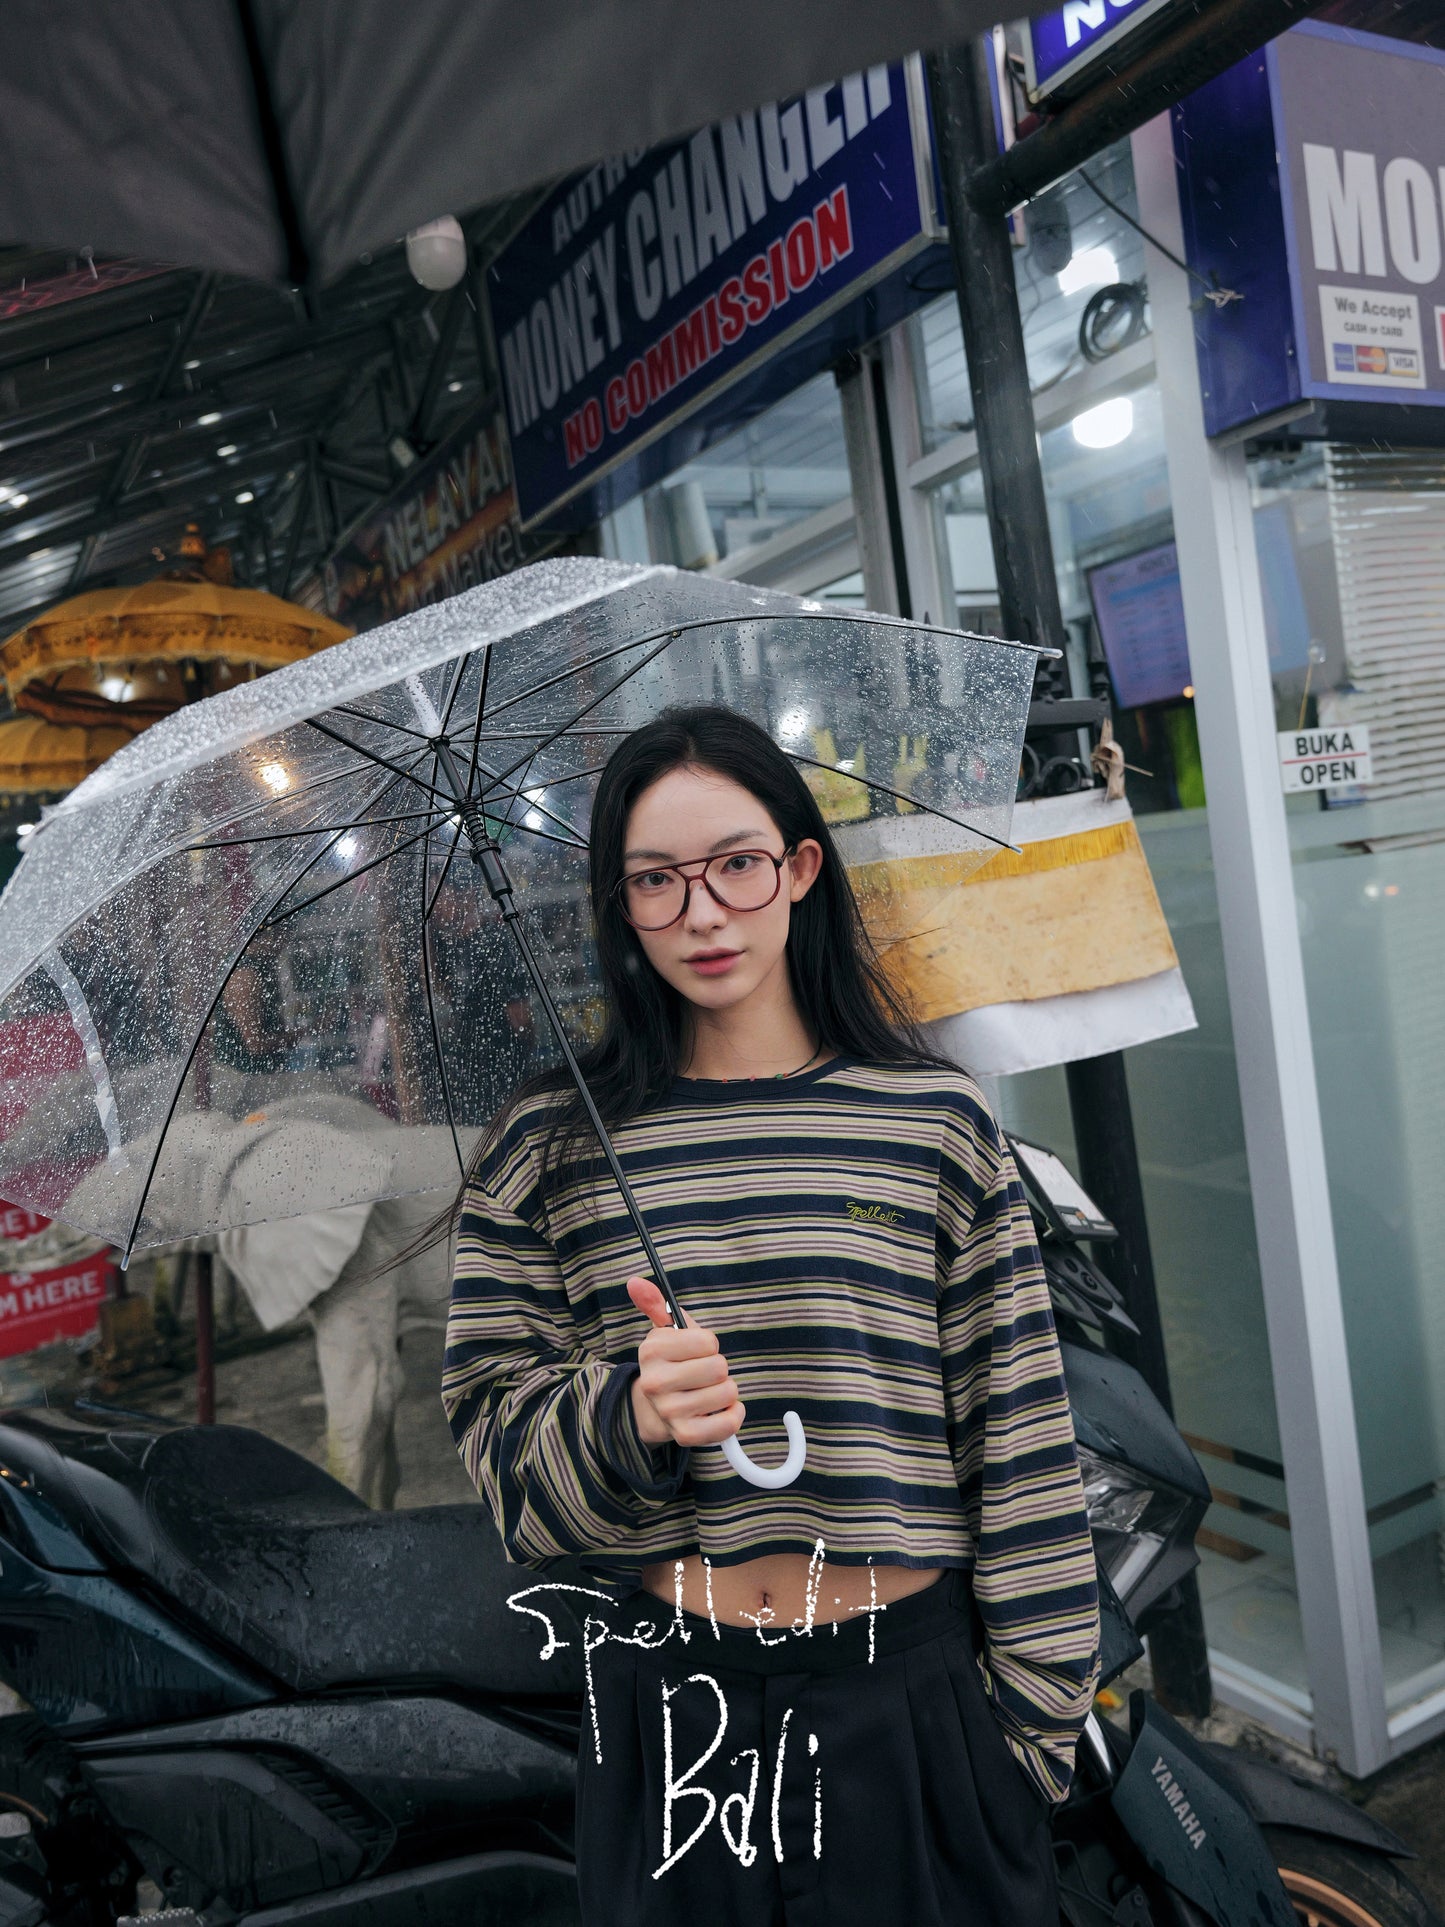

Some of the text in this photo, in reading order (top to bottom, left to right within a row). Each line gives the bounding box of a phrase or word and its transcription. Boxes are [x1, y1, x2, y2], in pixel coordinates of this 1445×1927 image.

[1303, 142, 1445, 285] MO
[562, 183, 854, 469] NO COMMISSION
[1334, 296, 1412, 322] We Accept
[502, 224, 622, 436] MONEY
[1392, 357, 1414, 368] VISA
[1295, 732, 1354, 756] BUKA
[1301, 761, 1356, 785] OPEN
[23, 1270, 101, 1311] HERE
[1151, 1755, 1207, 1850] YAMAHA
